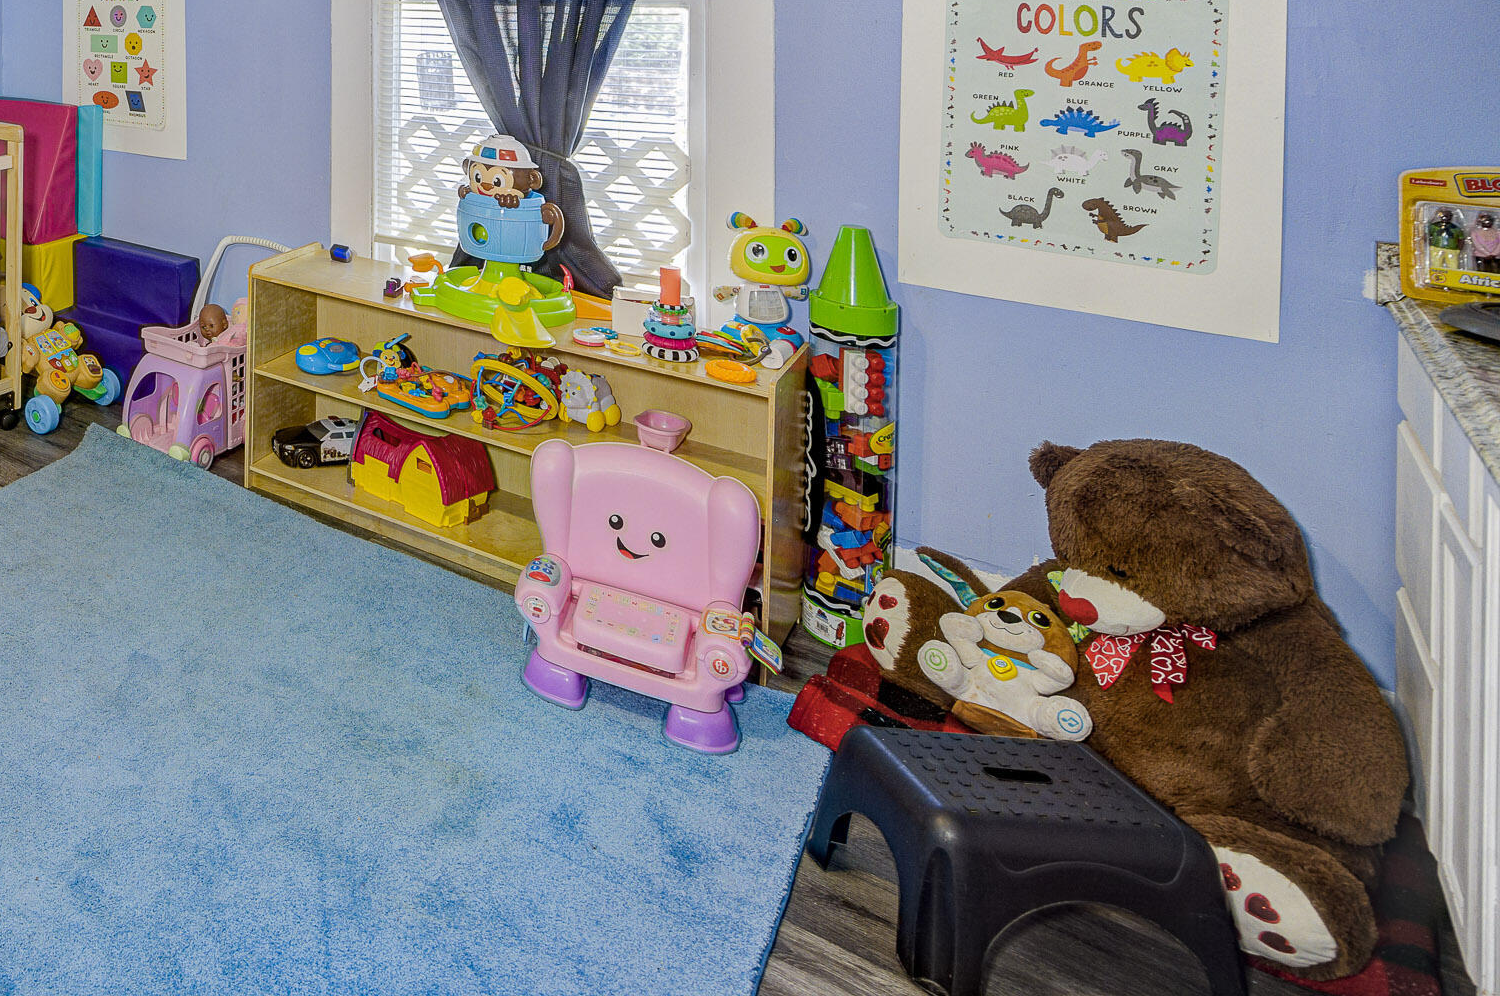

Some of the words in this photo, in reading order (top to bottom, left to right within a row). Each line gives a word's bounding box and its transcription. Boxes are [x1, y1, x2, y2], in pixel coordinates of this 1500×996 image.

[1016, 2, 1146, 40] COLORS
[1078, 80, 1115, 89] ORANGE
[1142, 84, 1183, 94] YELLOW
[972, 93, 999, 102] GREEN
[1066, 97, 1089, 106] BLUE
[1117, 130, 1151, 139] PURPLE
[1000, 144, 1020, 152] PINK
[1153, 164, 1179, 174] GRAY
[1056, 175, 1087, 185] WHITE
[1007, 194, 1036, 203] BLACK
[1122, 205, 1158, 215] BROWN
